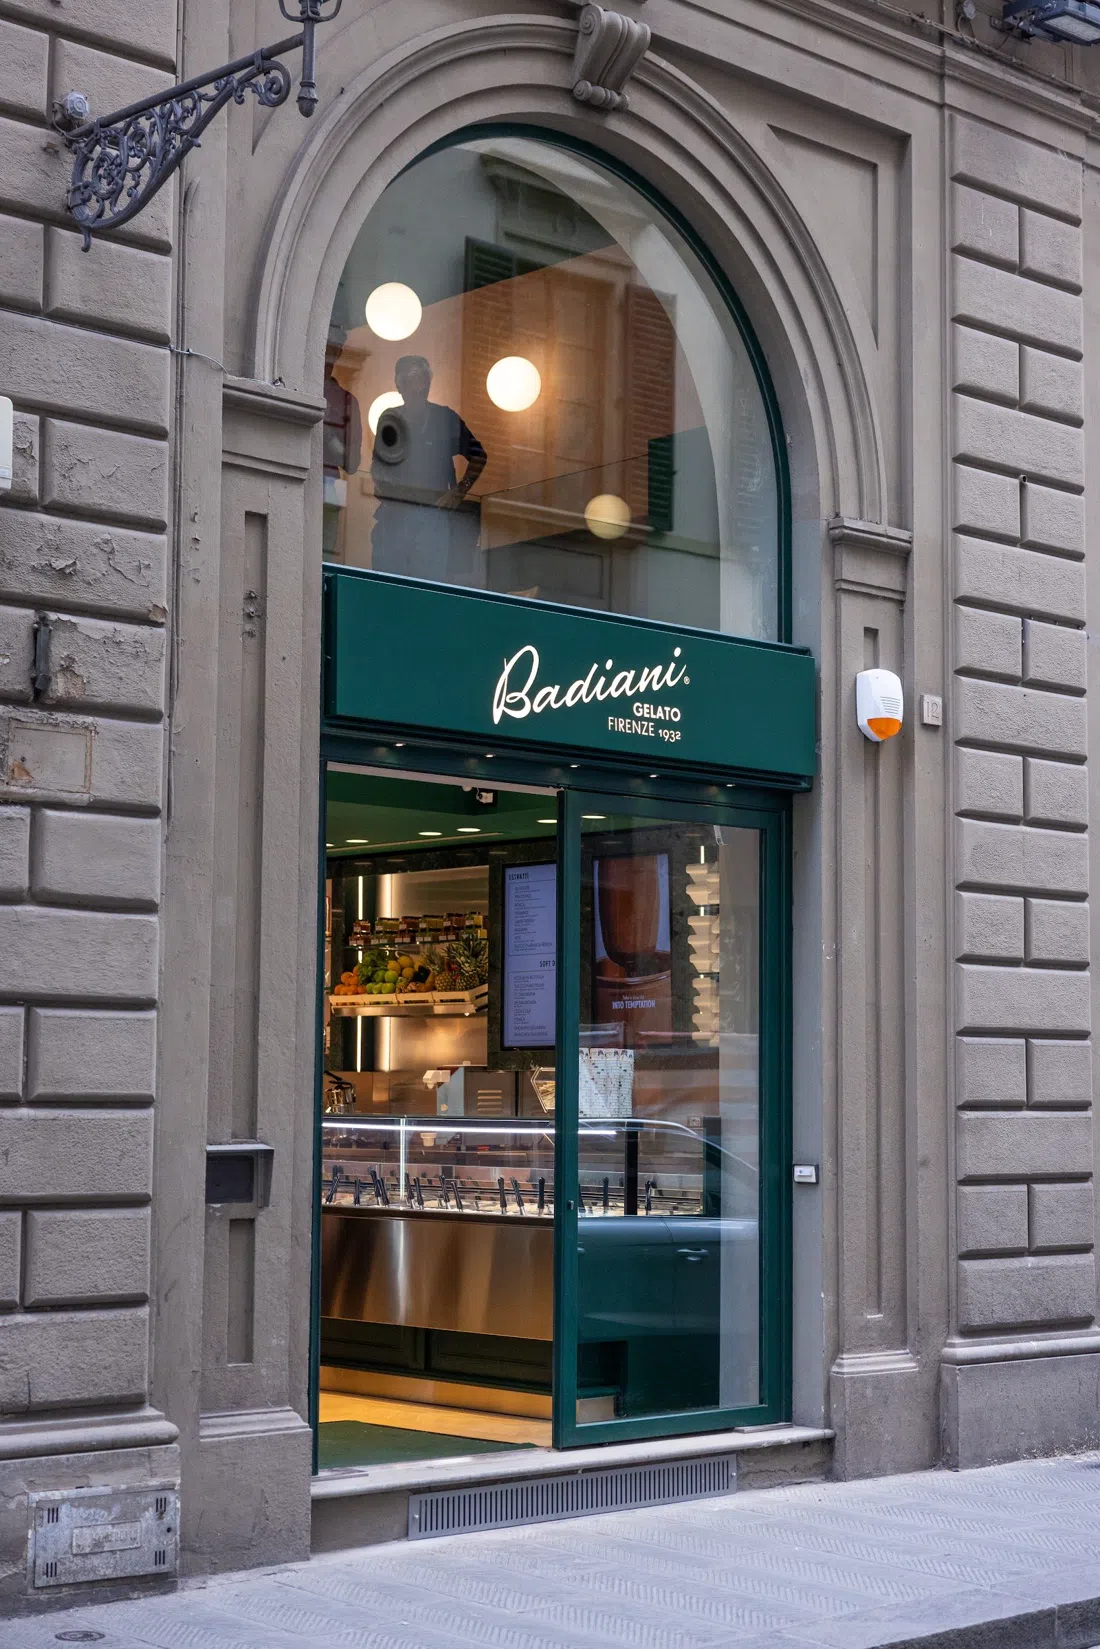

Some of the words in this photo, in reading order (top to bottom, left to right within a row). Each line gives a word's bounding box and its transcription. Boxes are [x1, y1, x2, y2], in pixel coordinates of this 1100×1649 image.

[633, 702, 681, 722] GELATO
[926, 701, 940, 719] 12
[608, 717, 655, 736] FIRENZE
[658, 729, 681, 743] 1932
[539, 960, 551, 968] SOFT
[612, 1001, 625, 1009] INTO
[625, 1000, 656, 1009] TEMPTATION
